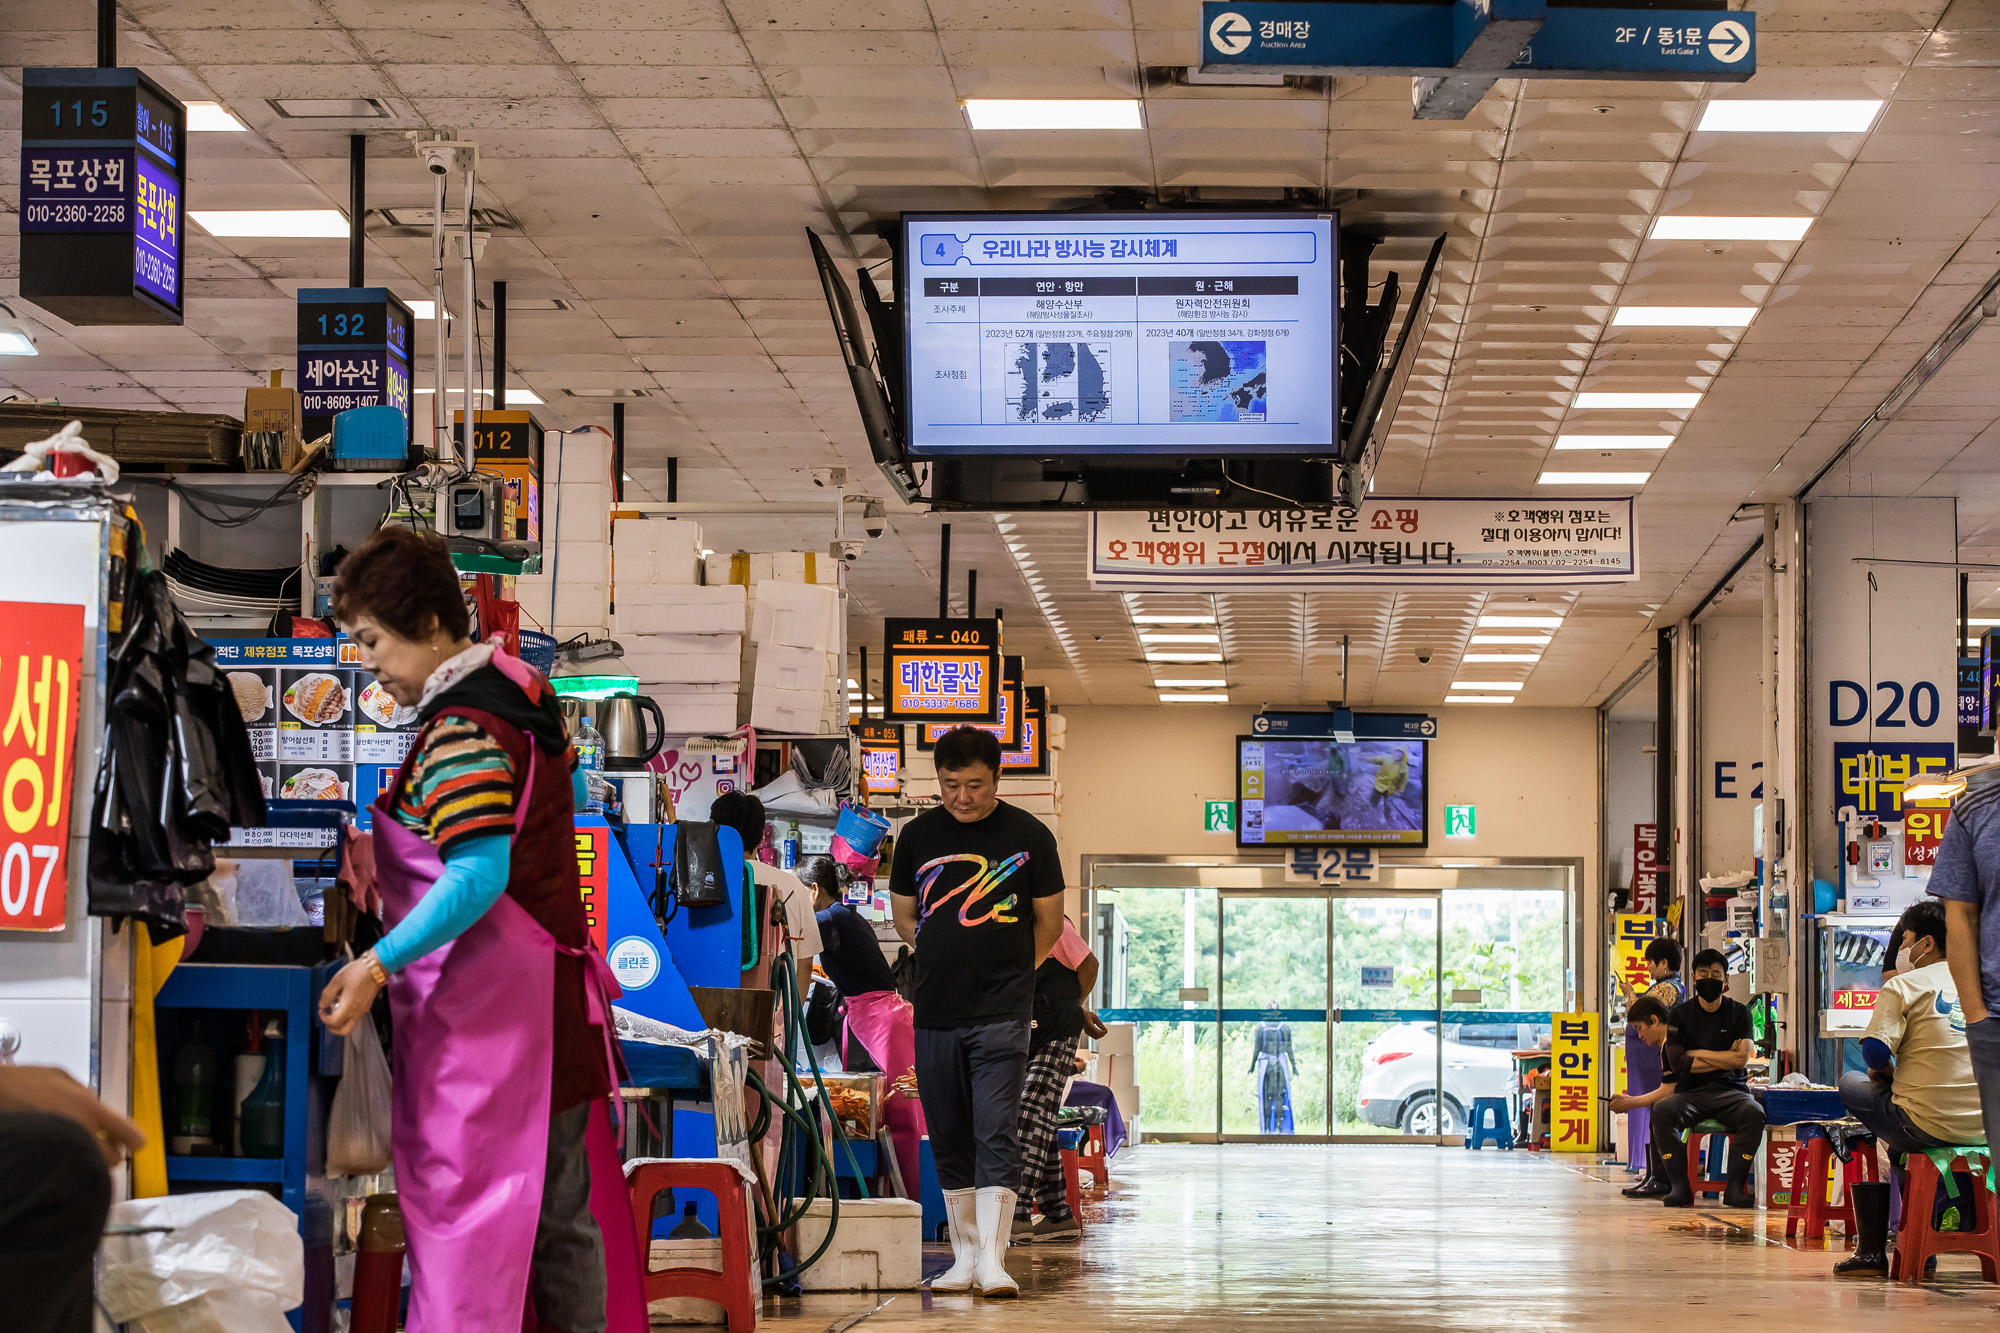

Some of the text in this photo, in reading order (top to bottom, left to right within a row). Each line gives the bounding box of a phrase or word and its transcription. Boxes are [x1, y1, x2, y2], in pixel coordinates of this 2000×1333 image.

[1259, 20, 1311, 39] 경매장
[1615, 27, 1637, 43] 2F
[1657, 27, 1703, 45] 동1문
[1260, 40, 1306, 49] Auction Area
[50, 100, 108, 127] 115
[29, 158, 125, 192] 목포상회
[27, 204, 125, 223] 010-2360-2258
[137, 173, 176, 247] 목포상회
[934, 242, 945, 257] 4
[982, 238, 1178, 259] 우리나라 방사능 감시체계
[135, 245, 176, 295] 010-2360-2258
[939, 281, 960, 293] 구분
[1036, 281, 1056, 293] 연안
[1064, 281, 1084, 293] 항만
[1195, 280, 1205, 292] 원
[1213, 280, 1234, 292] 근해
[933, 305, 966, 314] 조사주체
[1035, 299, 1083, 310] 해양수산부
[1175, 298, 1251, 309] 원자력안전위원회
[1177, 311, 1249, 319] (해양환경 방사능 감시)
[318, 313, 365, 336] 132
[985, 329, 1013, 339] 2023년
[1014, 329, 1034, 339] 52개
[1146, 328, 1174, 338] 2023년
[1175, 328, 1195, 337] 40개
[305, 359, 379, 386] 세아수산
[934, 371, 967, 380] 조사정점
[303, 395, 379, 410] 010-8609-1407
[1147, 508, 1419, 534] 편안하고 여유로운 쇼핑
[1568, 509, 1611, 524] 점포는
[1480, 526, 1622, 542] 절대 이용하지 맙시다!
[1216, 541, 1317, 565] 근절에서
[1327, 541, 1462, 565] 시작됩니다.
[1482, 559, 1548, 567] 02-2254-8003
[1555, 557, 1621, 566] 02-2254-8145
[902, 629, 929, 644] 패류
[951, 630, 980, 644] 040
[214, 645, 336, 659] 적단 제휴점포 목포상회
[901, 698, 980, 709] 010-5337-1686
[1829, 680, 1941, 727] D20
[281, 736, 316, 745] 방어삼선회
[884, 728, 896, 739] 055
[279, 831, 314, 839] 다다익선회
[1290, 848, 1375, 881] 북2문
[618, 956, 650, 970] 클린존
